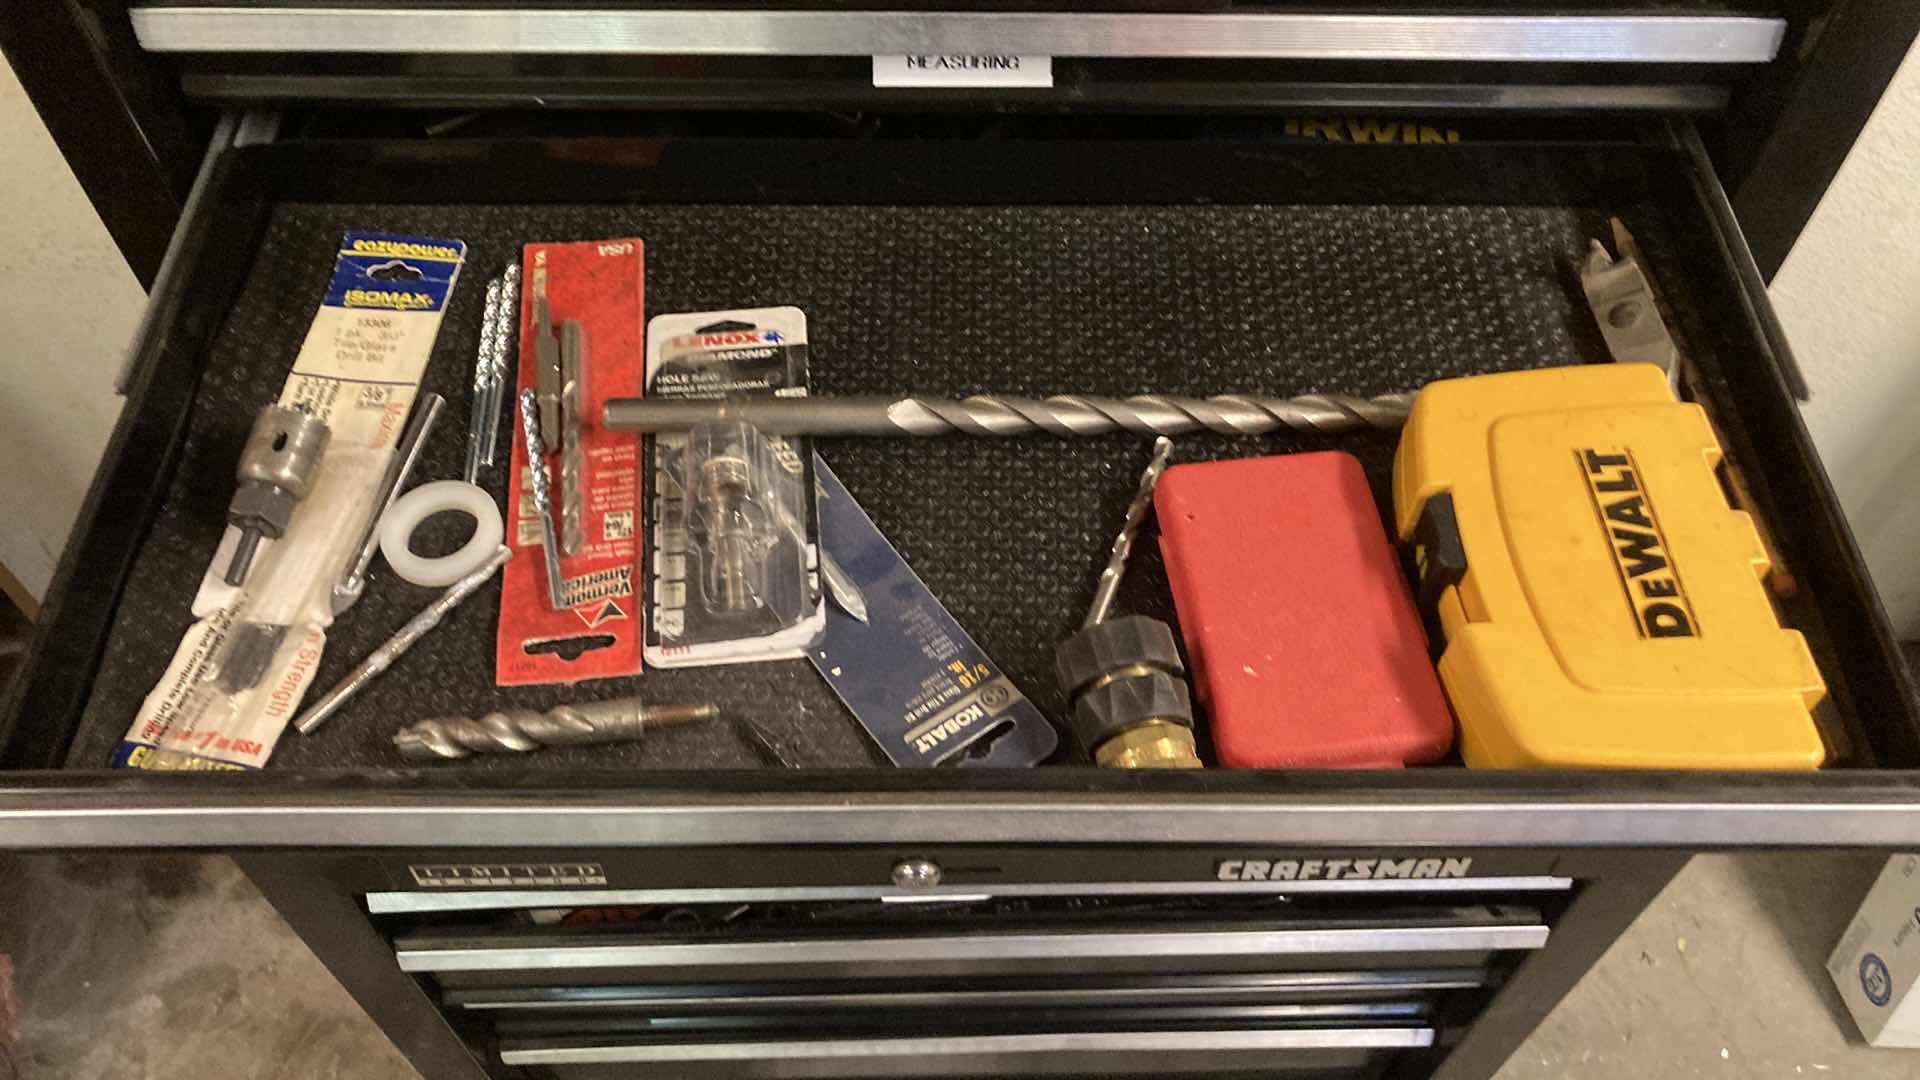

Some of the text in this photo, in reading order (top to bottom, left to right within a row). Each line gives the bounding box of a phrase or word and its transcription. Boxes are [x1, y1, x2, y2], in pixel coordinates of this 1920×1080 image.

[907, 56, 980, 70] MEASURING
[672, 332, 760, 349] LENOX
[1586, 447, 1696, 640] DEWALT
[914, 704, 985, 755] KOBALT
[1216, 856, 1473, 881] CRAFTSMAN
